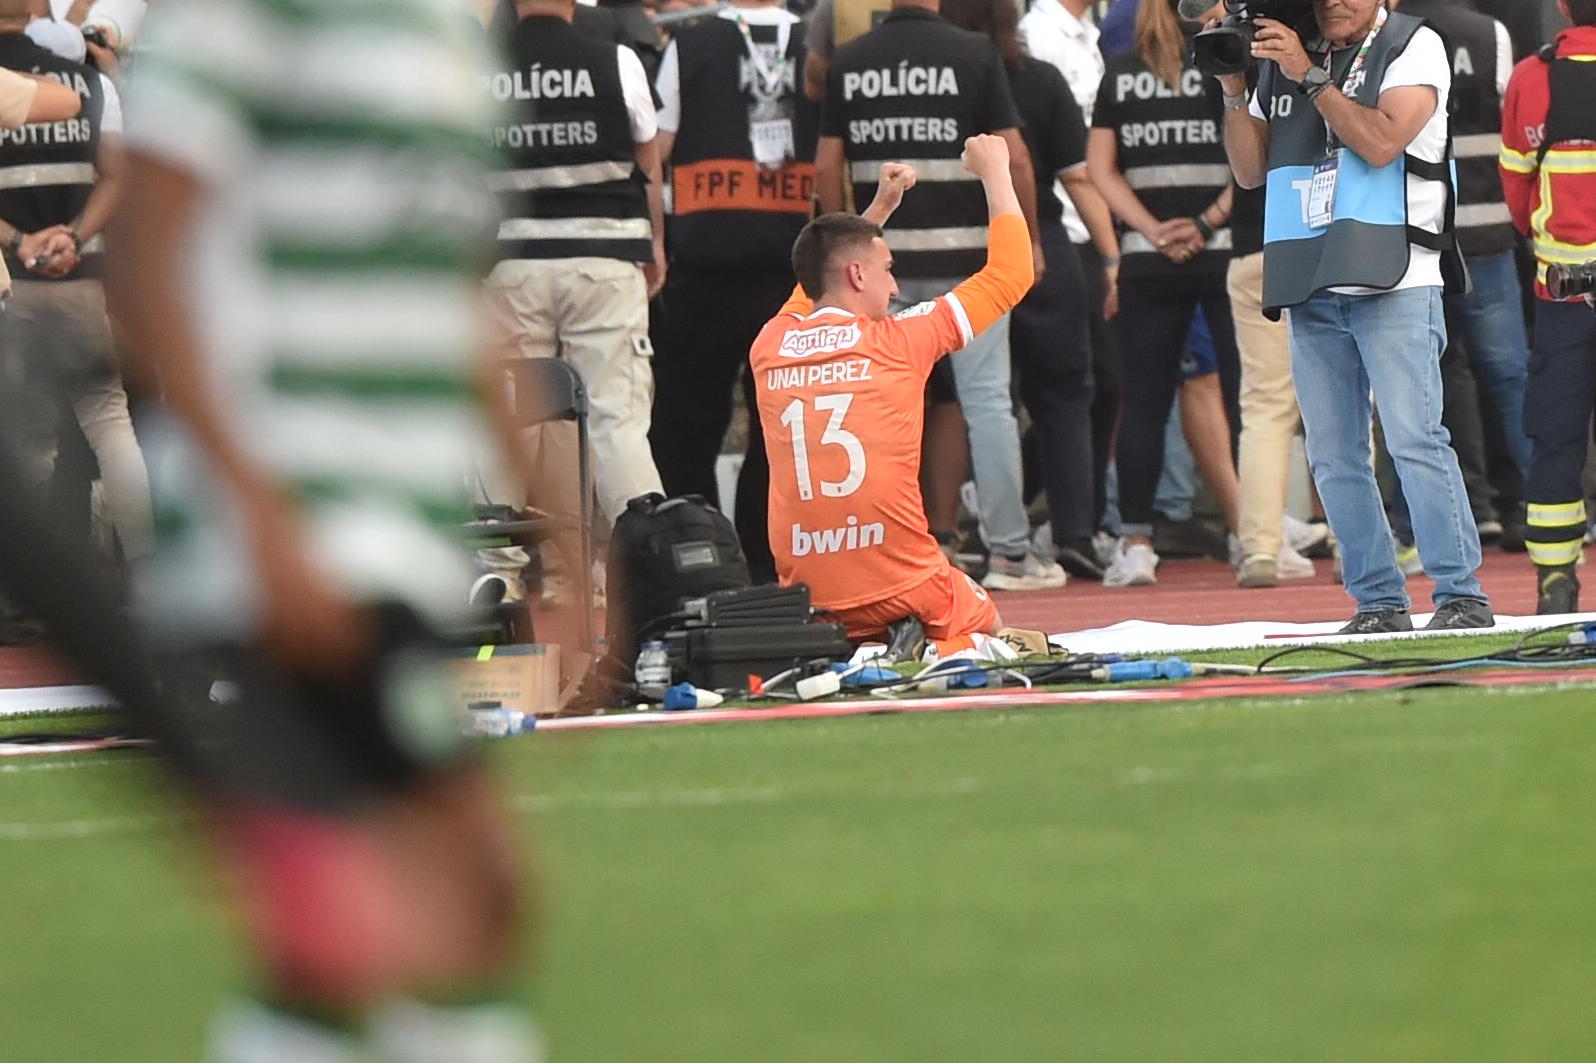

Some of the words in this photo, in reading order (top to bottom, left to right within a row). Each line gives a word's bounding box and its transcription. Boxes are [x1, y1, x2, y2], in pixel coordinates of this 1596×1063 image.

[843, 59, 959, 101] POLÍCIA
[1116, 68, 1206, 102] POLC
[0, 117, 92, 148] POTTERS
[491, 120, 599, 149] POTTERS
[849, 116, 959, 144] SPOTTERS
[1120, 119, 1219, 148] SPOTTER
[693, 169, 743, 202] FPF
[756, 171, 814, 201] MED
[767, 366, 806, 391] UNAI
[807, 358, 873, 387] PEREZ
[780, 392, 867, 502] 13
[791, 514, 885, 557] bwin
